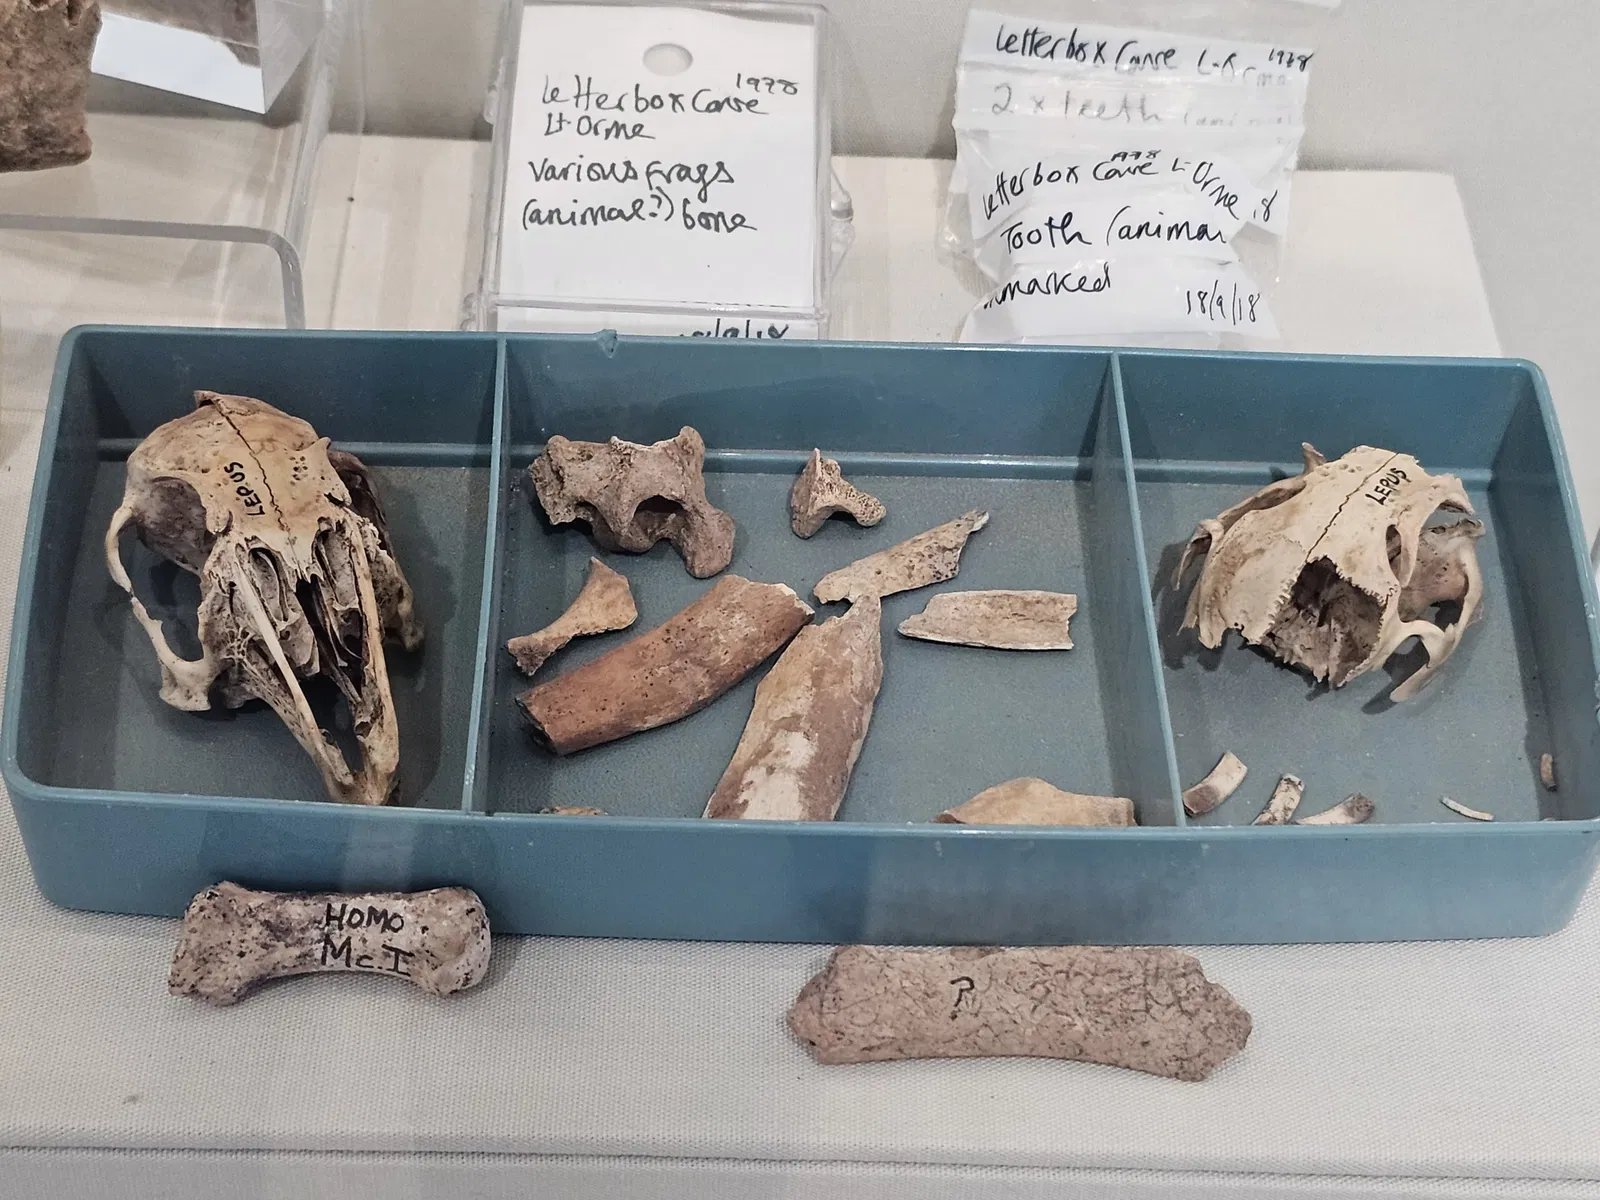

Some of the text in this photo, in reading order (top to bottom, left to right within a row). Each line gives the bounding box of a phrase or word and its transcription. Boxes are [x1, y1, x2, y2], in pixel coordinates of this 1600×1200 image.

[996, 24, 1107, 65] Letterbox
[576, 115, 657, 141] Orme
[1093, 161, 1160, 182] Cave
[682, 197, 759, 233] bone
[1000, 211, 1093, 255] Tooth
[1185, 279, 1262, 326] 18/9/18
[224, 461, 266, 517] LEPUS
[1364, 467, 1412, 506] LEPUS
[325, 902, 405, 934] HOMO
